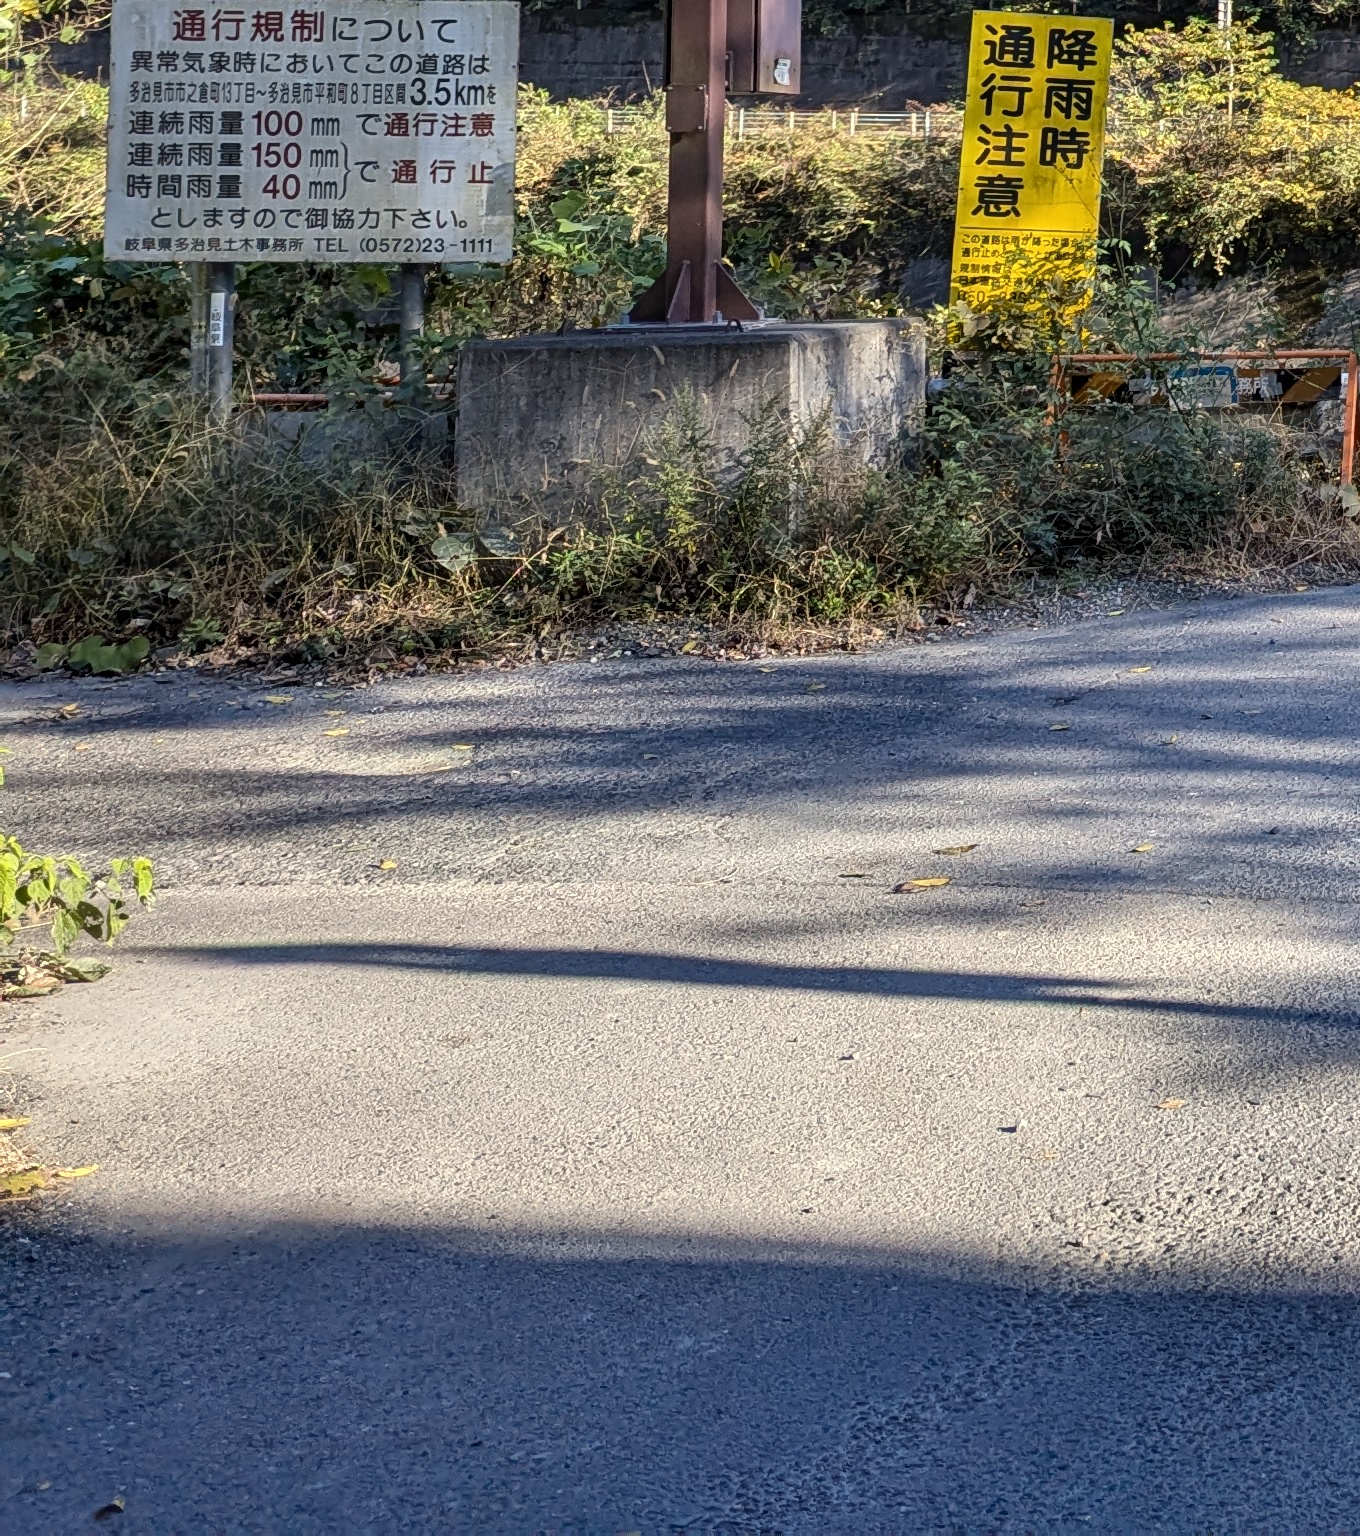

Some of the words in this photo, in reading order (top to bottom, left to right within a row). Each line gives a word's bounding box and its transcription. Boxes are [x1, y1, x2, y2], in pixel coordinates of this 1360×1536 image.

[172, 8, 459, 44] 通行規制について
[130, 50, 491, 76] 異常気象時においてこの道路は
[1038, 27, 1098, 170] 降雨時
[970, 24, 1036, 218] 通行注意
[151, 206, 468, 231] としますので御協力下さい。
[124, 237, 305, 252] 岐阜県多治見土木事務所
[313, 238, 350, 253] TEL
[360, 237, 493, 253] (0572)23-1111
